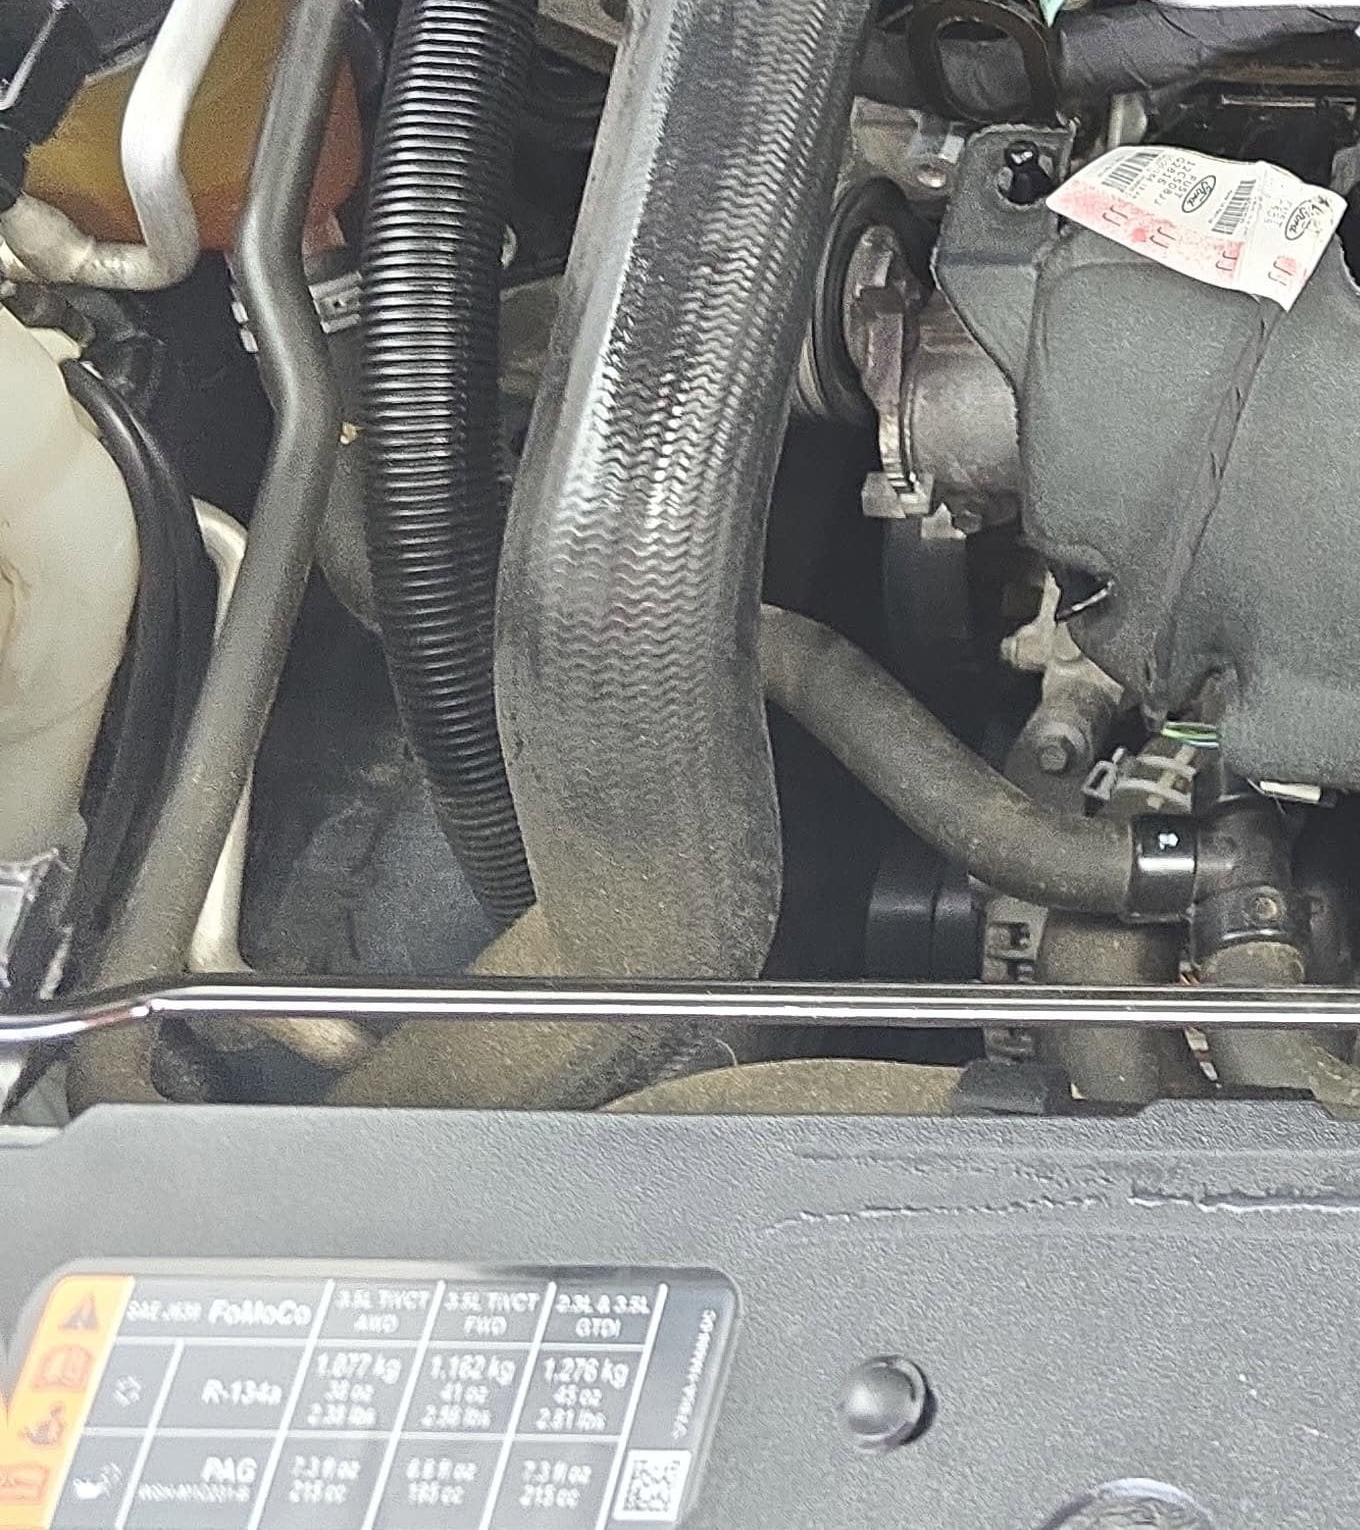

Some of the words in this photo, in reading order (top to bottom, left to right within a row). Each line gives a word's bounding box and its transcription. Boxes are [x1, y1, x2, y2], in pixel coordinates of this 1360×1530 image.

[208, 1299, 313, 1325] FoMoCo
[464, 1316, 507, 1336] FWD
[373, 1352, 402, 1384] kg
[487, 1355, 517, 1387] kg
[601, 1357, 630, 1390] kg
[201, 1379, 283, 1406] R-134a
[201, 1456, 259, 1484] PAG
